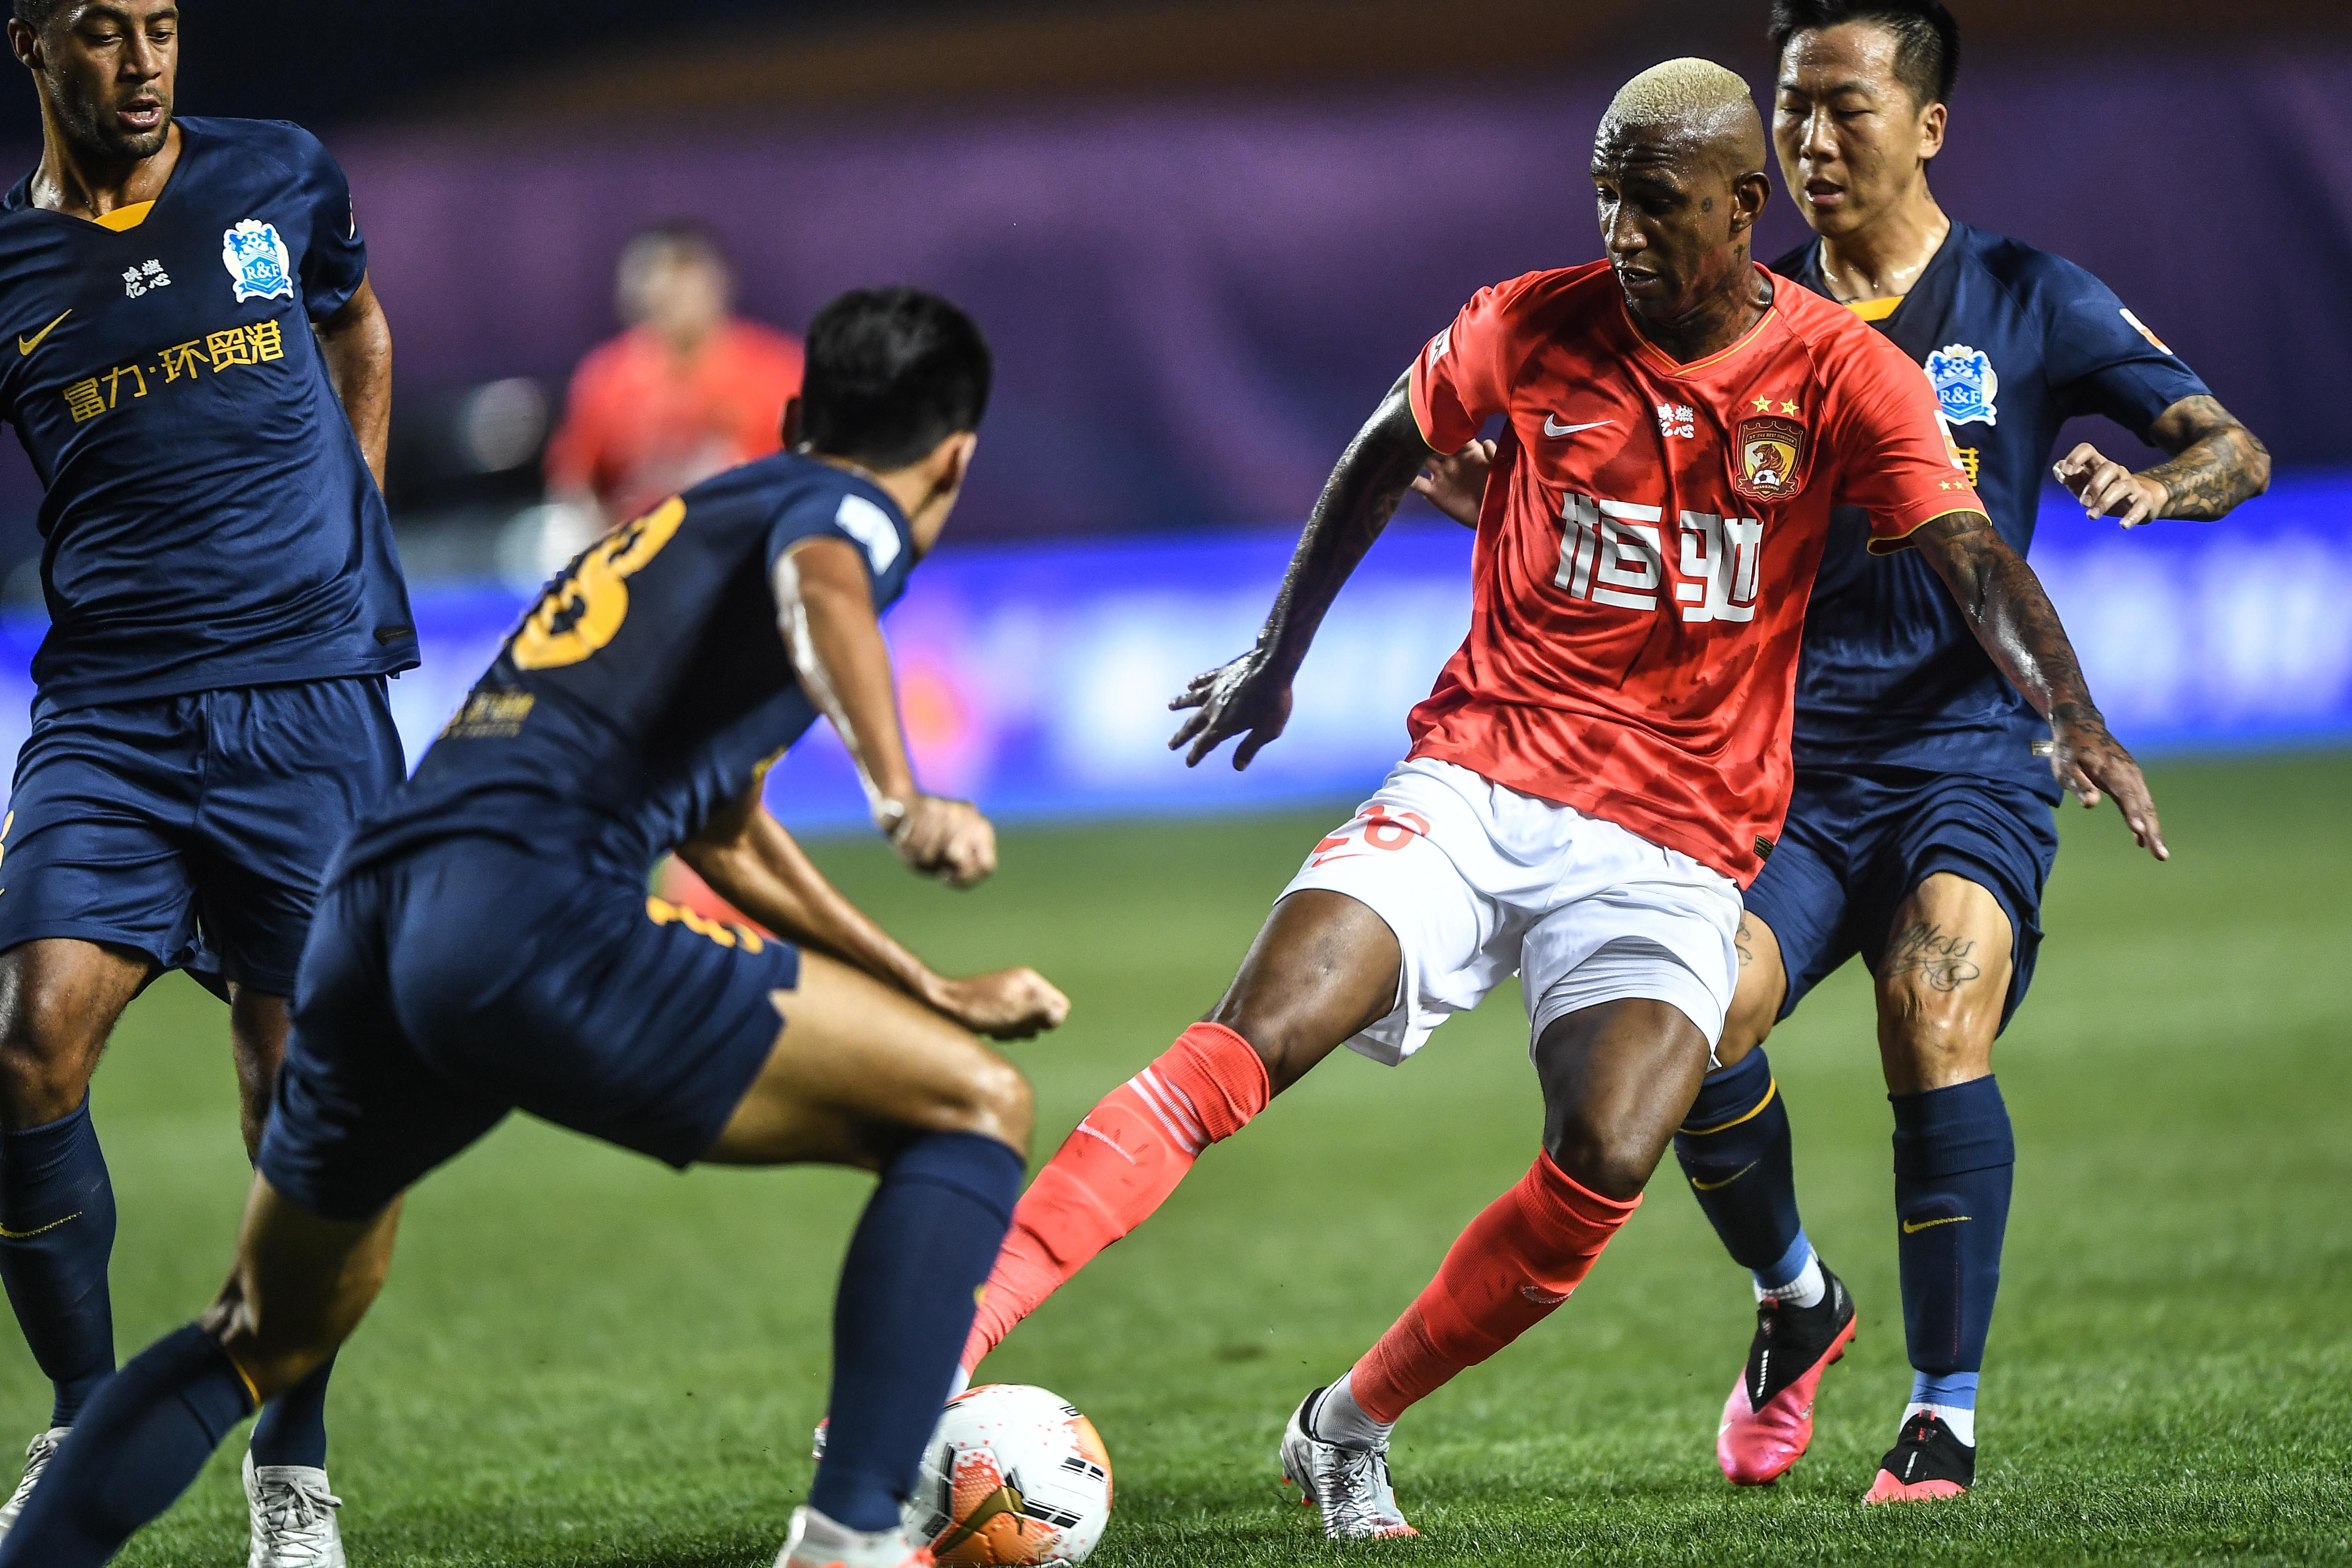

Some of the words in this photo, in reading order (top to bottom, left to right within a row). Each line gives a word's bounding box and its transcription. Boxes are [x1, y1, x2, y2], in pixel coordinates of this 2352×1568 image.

[244, 261, 280, 280] R&F
[63, 320, 284, 423] 富力·环贸港
[1939, 387, 1981, 403] R&F
